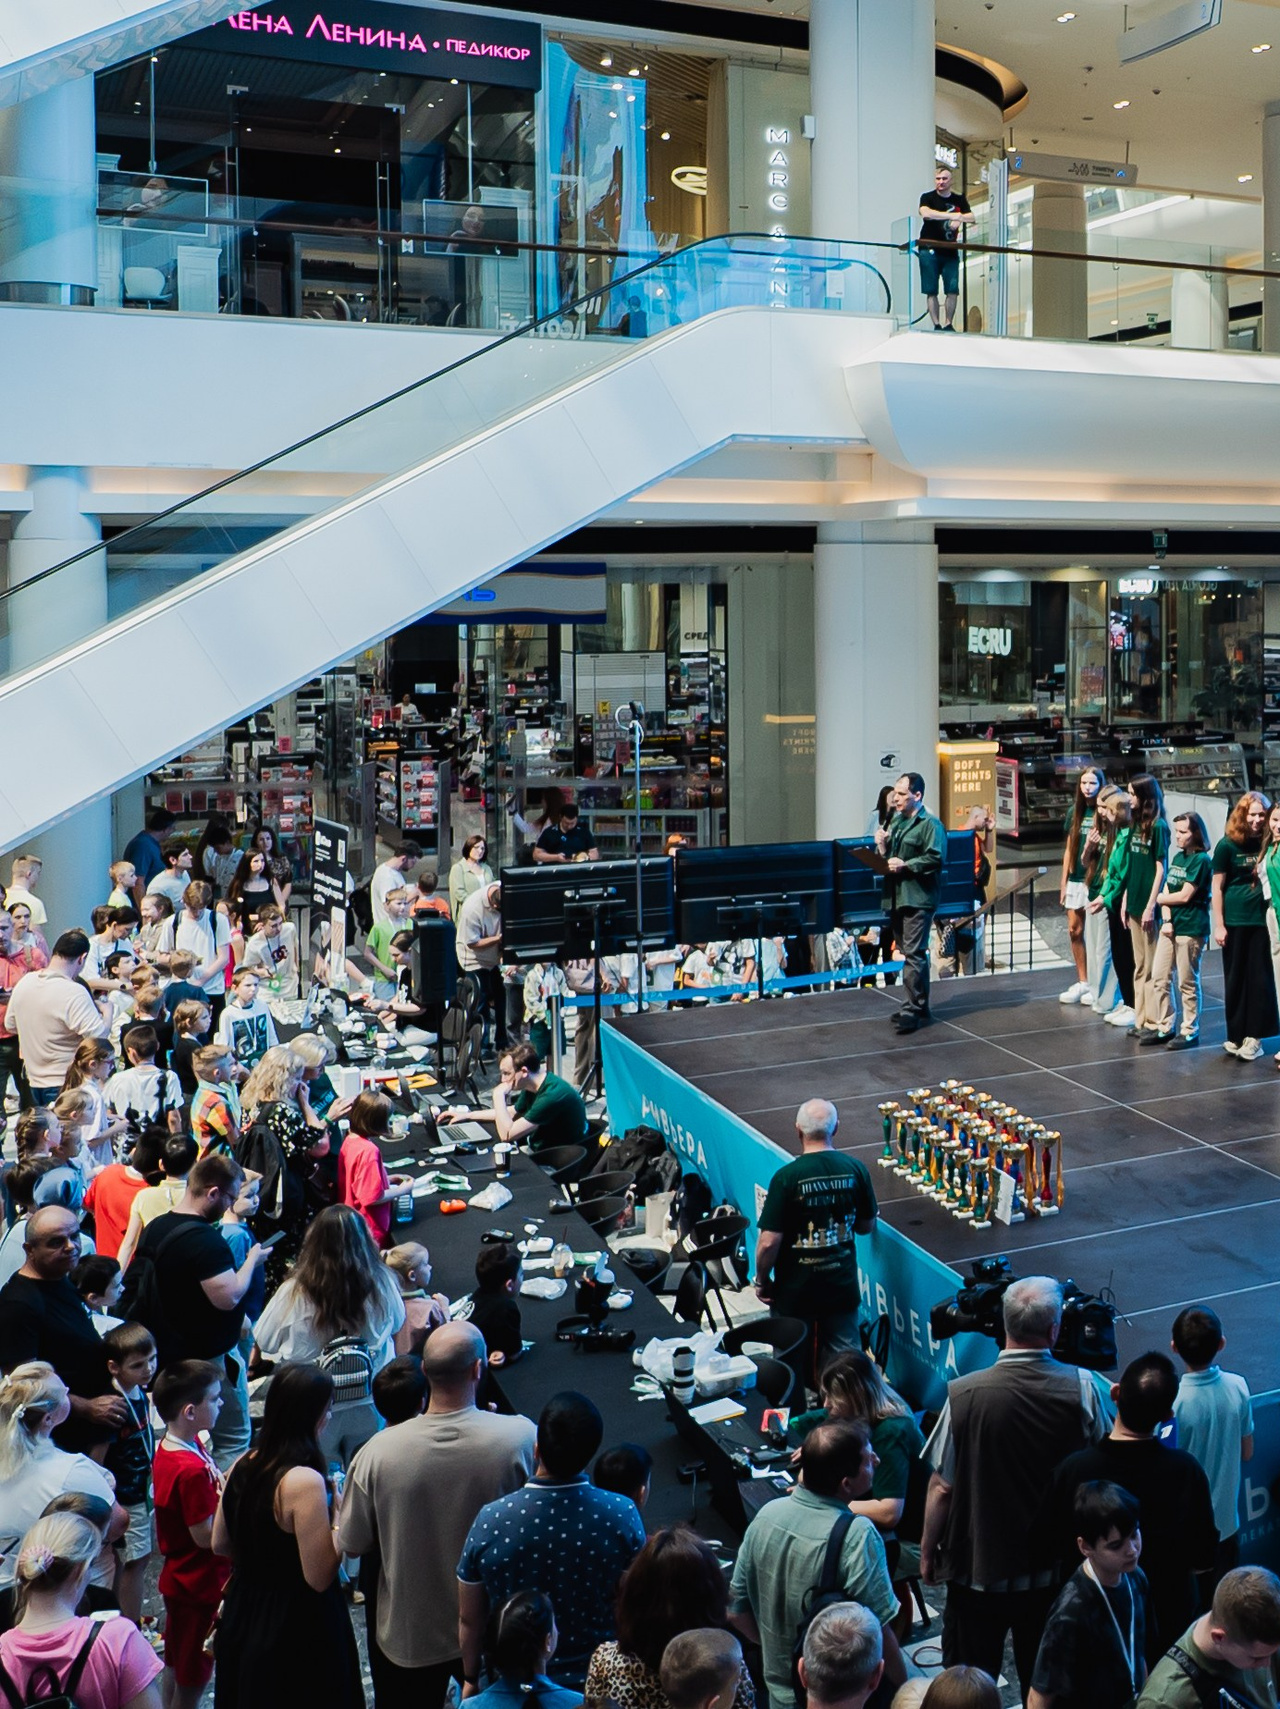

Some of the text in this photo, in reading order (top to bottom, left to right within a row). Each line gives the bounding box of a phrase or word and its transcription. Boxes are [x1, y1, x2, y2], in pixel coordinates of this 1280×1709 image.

[305, 14, 428, 53] ЛЕНИНА
[445, 38, 531, 61] ПЕДИКЮР
[767, 127, 790, 211] MARC
[967, 625, 1012, 656] ECRU
[954, 760, 981, 770] BOFT
[954, 770, 992, 781] PRINTS
[954, 782, 982, 792] HERE
[857, 1266, 961, 1378] ИВЬЕРА
